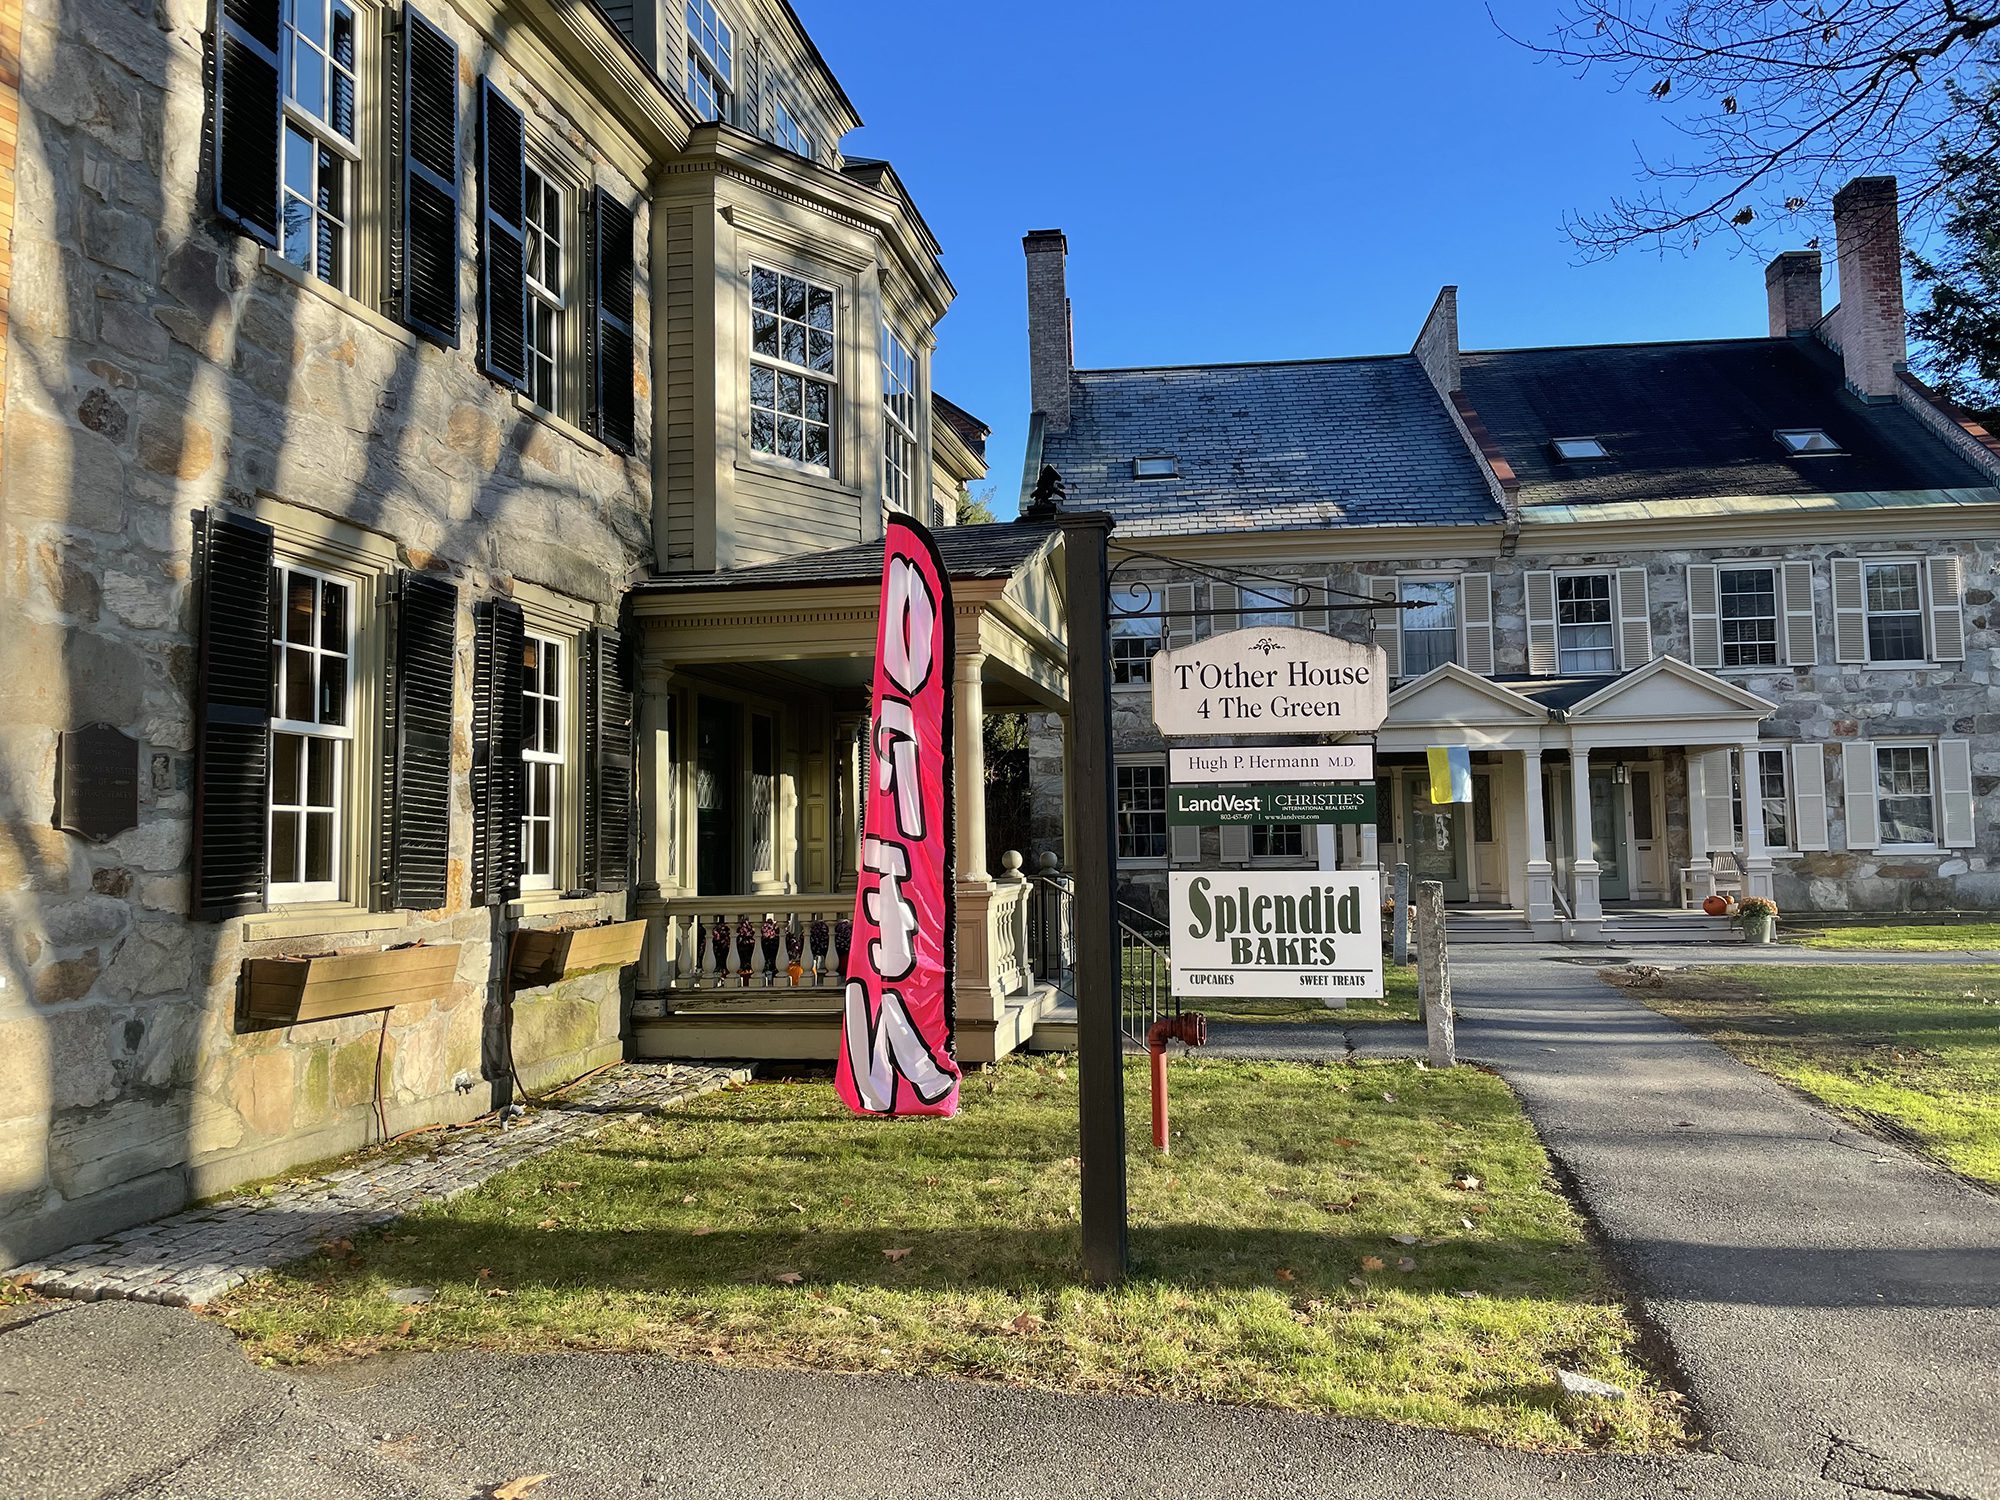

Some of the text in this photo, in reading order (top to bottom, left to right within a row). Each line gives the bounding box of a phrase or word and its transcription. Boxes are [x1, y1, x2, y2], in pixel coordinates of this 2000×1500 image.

[1174, 660, 1370, 690] T'Other House
[1197, 695, 1341, 719] 4 The Green
[1189, 755, 1356, 773] Hugh P. Hermann M.D.
[1178, 795, 1262, 812] LandVest
[1275, 793, 1365, 806] CHRISTIE'S
[1188, 876, 1362, 943] Splendid
[1230, 937, 1336, 966] BAKES
[1189, 974, 1235, 985] CUPCAKES
[1300, 975, 1365, 986] SWEET TREATS
